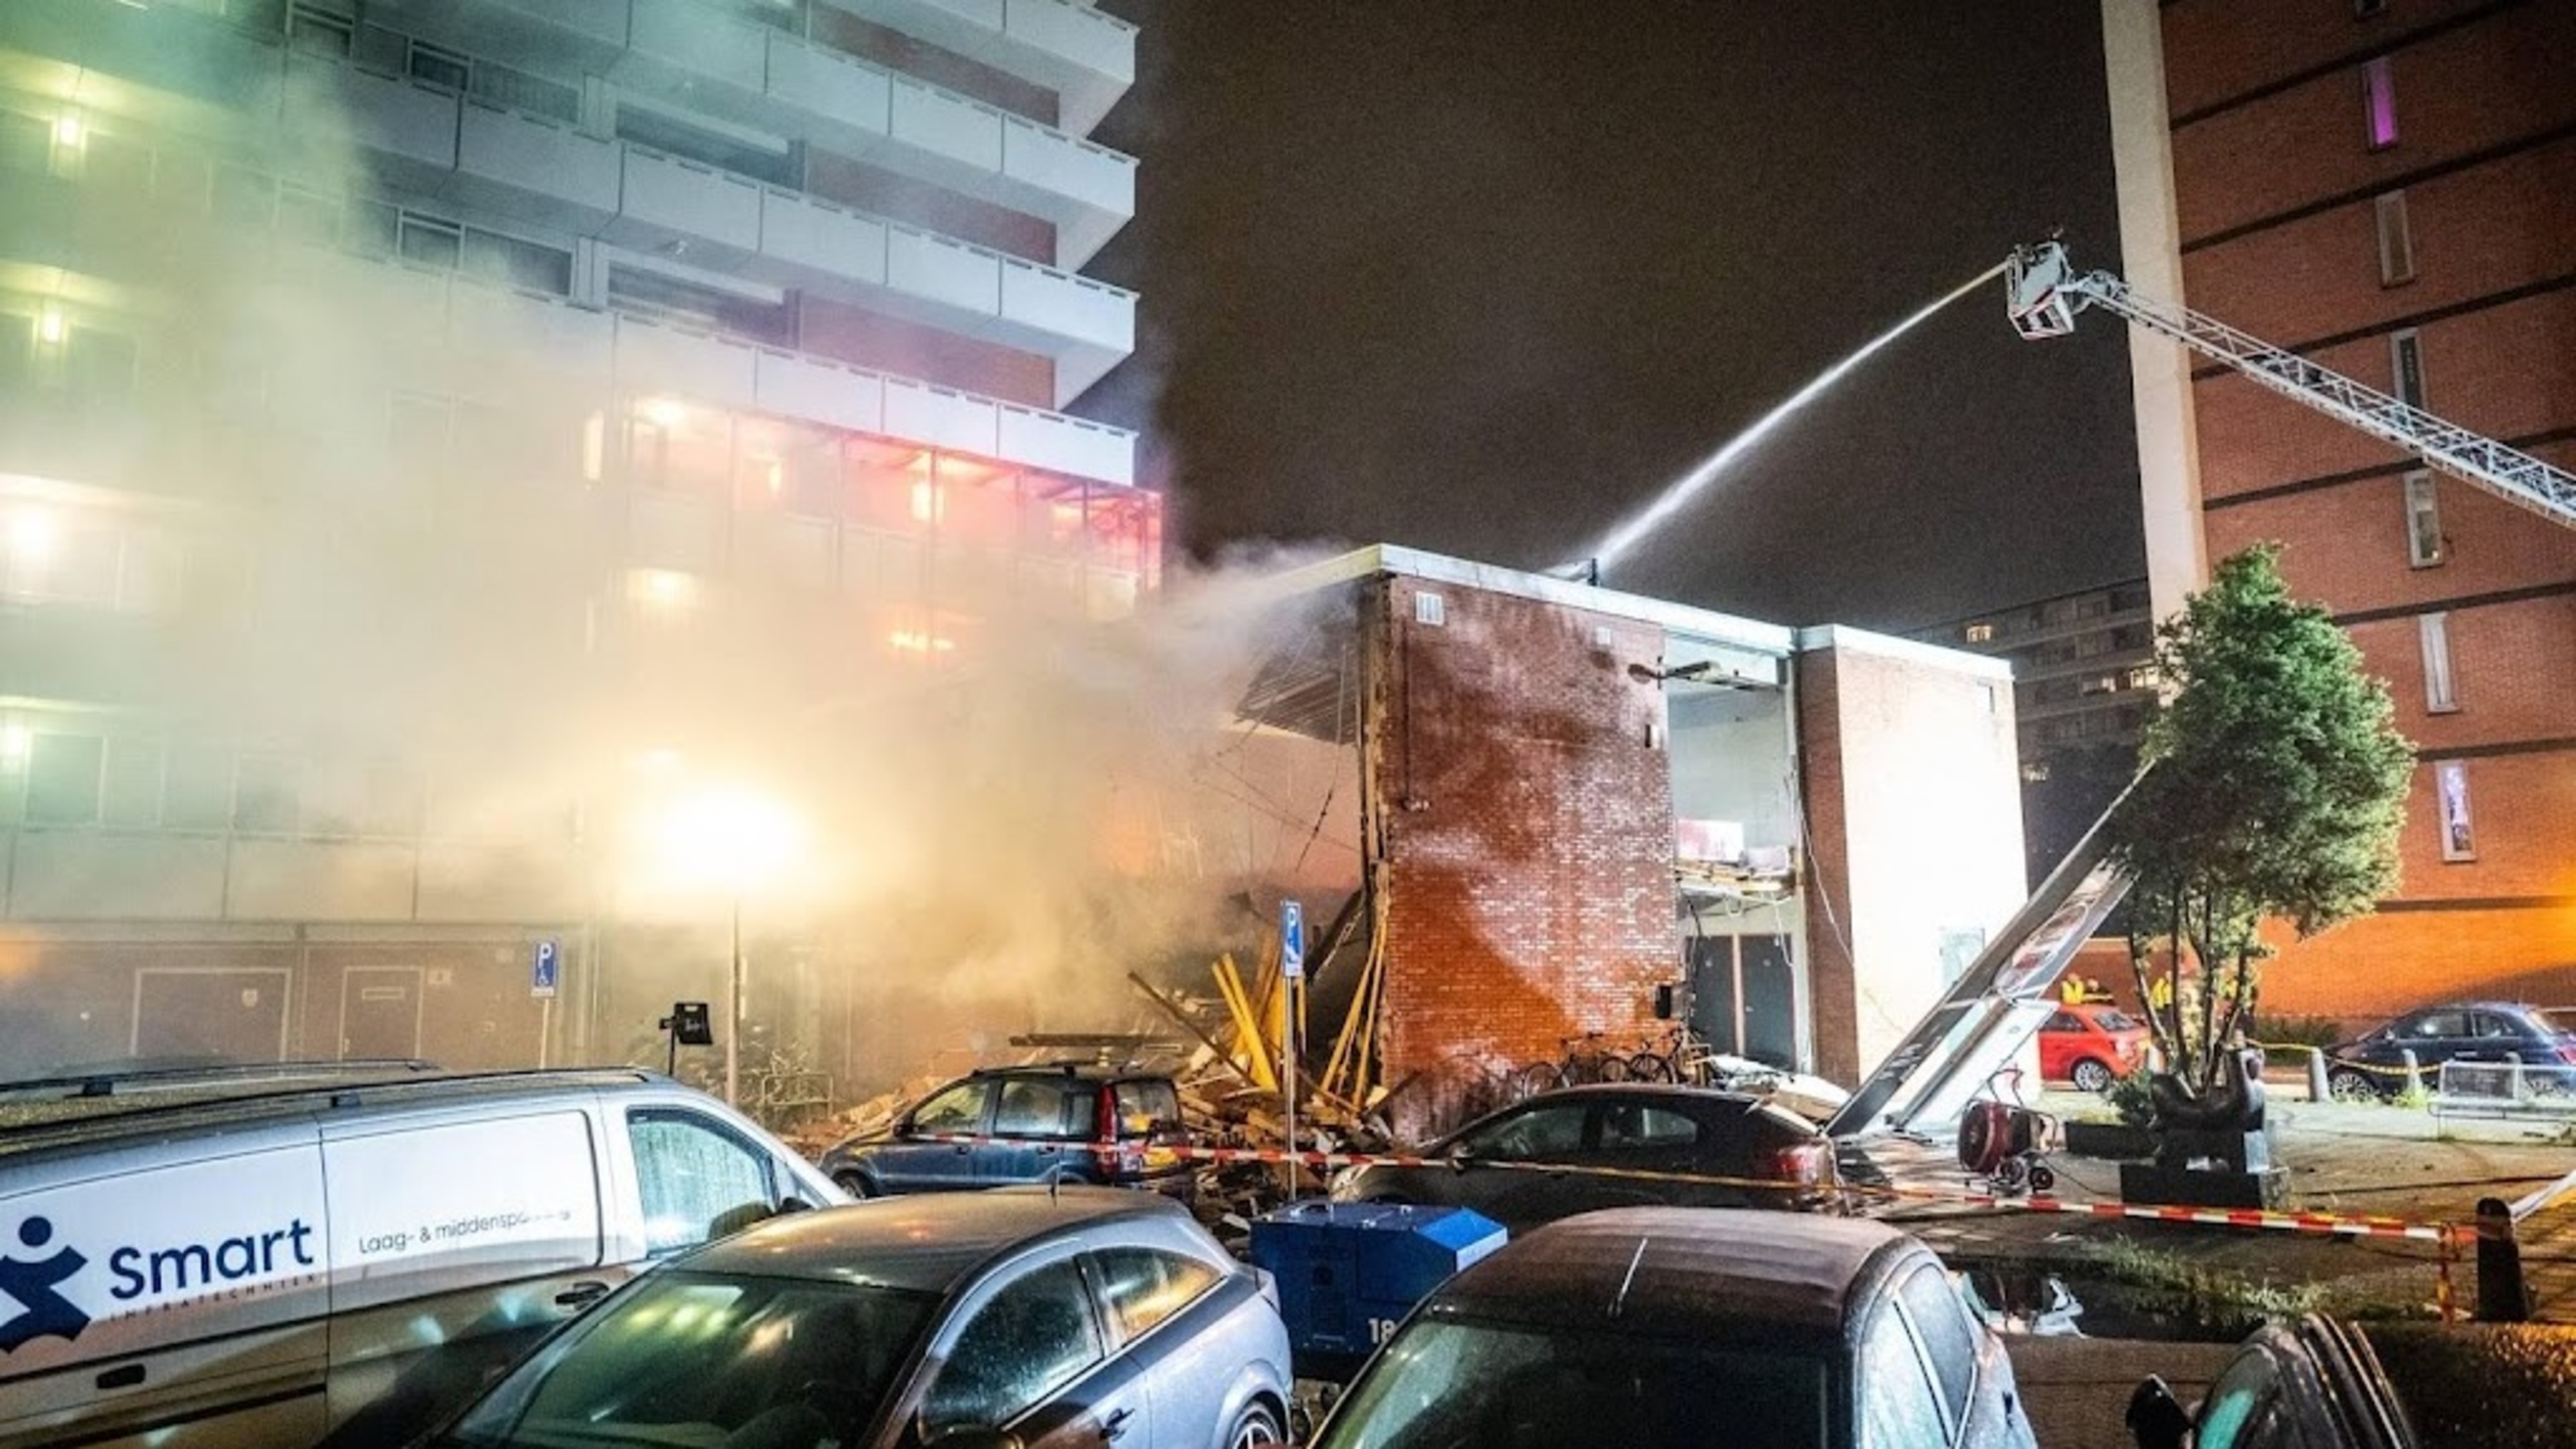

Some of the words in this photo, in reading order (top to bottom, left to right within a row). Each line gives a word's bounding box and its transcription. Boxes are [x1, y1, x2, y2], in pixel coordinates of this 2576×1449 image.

[539, 943, 552, 968] P
[419, 1227, 431, 1242] &
[1368, 1318, 1396, 1344] 18
